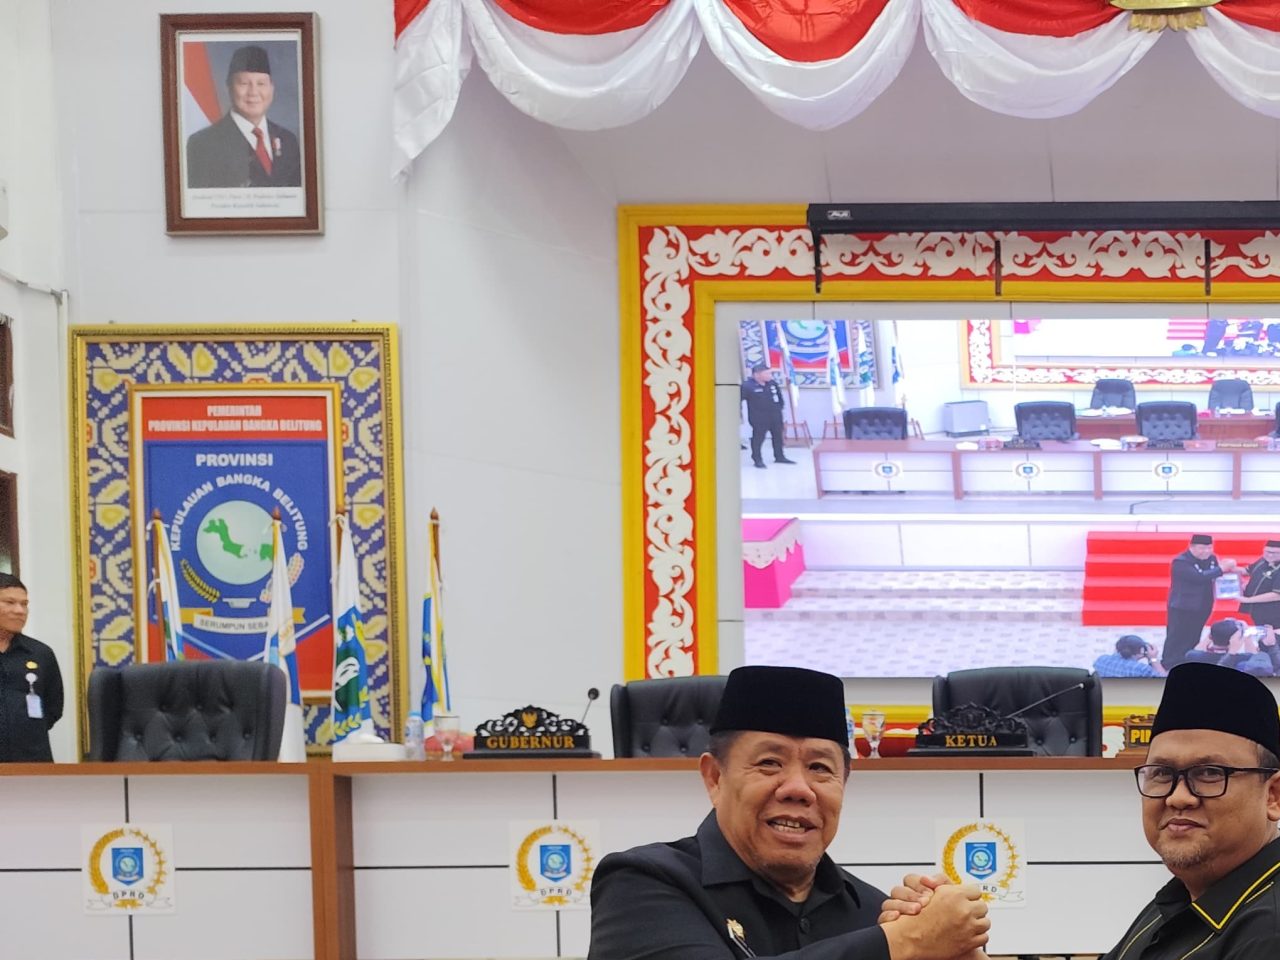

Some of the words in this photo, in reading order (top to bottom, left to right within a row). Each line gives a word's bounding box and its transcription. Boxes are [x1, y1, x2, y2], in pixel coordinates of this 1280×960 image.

[195, 452, 273, 467] PROVINSI
[170, 481, 214, 551] KEPULAUAN
[215, 472, 271, 492] BANGKA
[272, 487, 309, 551] BELITUNG
[199, 618, 246, 631] SERUMPUN
[486, 735, 575, 749] GUBERNUR
[945, 734, 998, 748] KETUA
